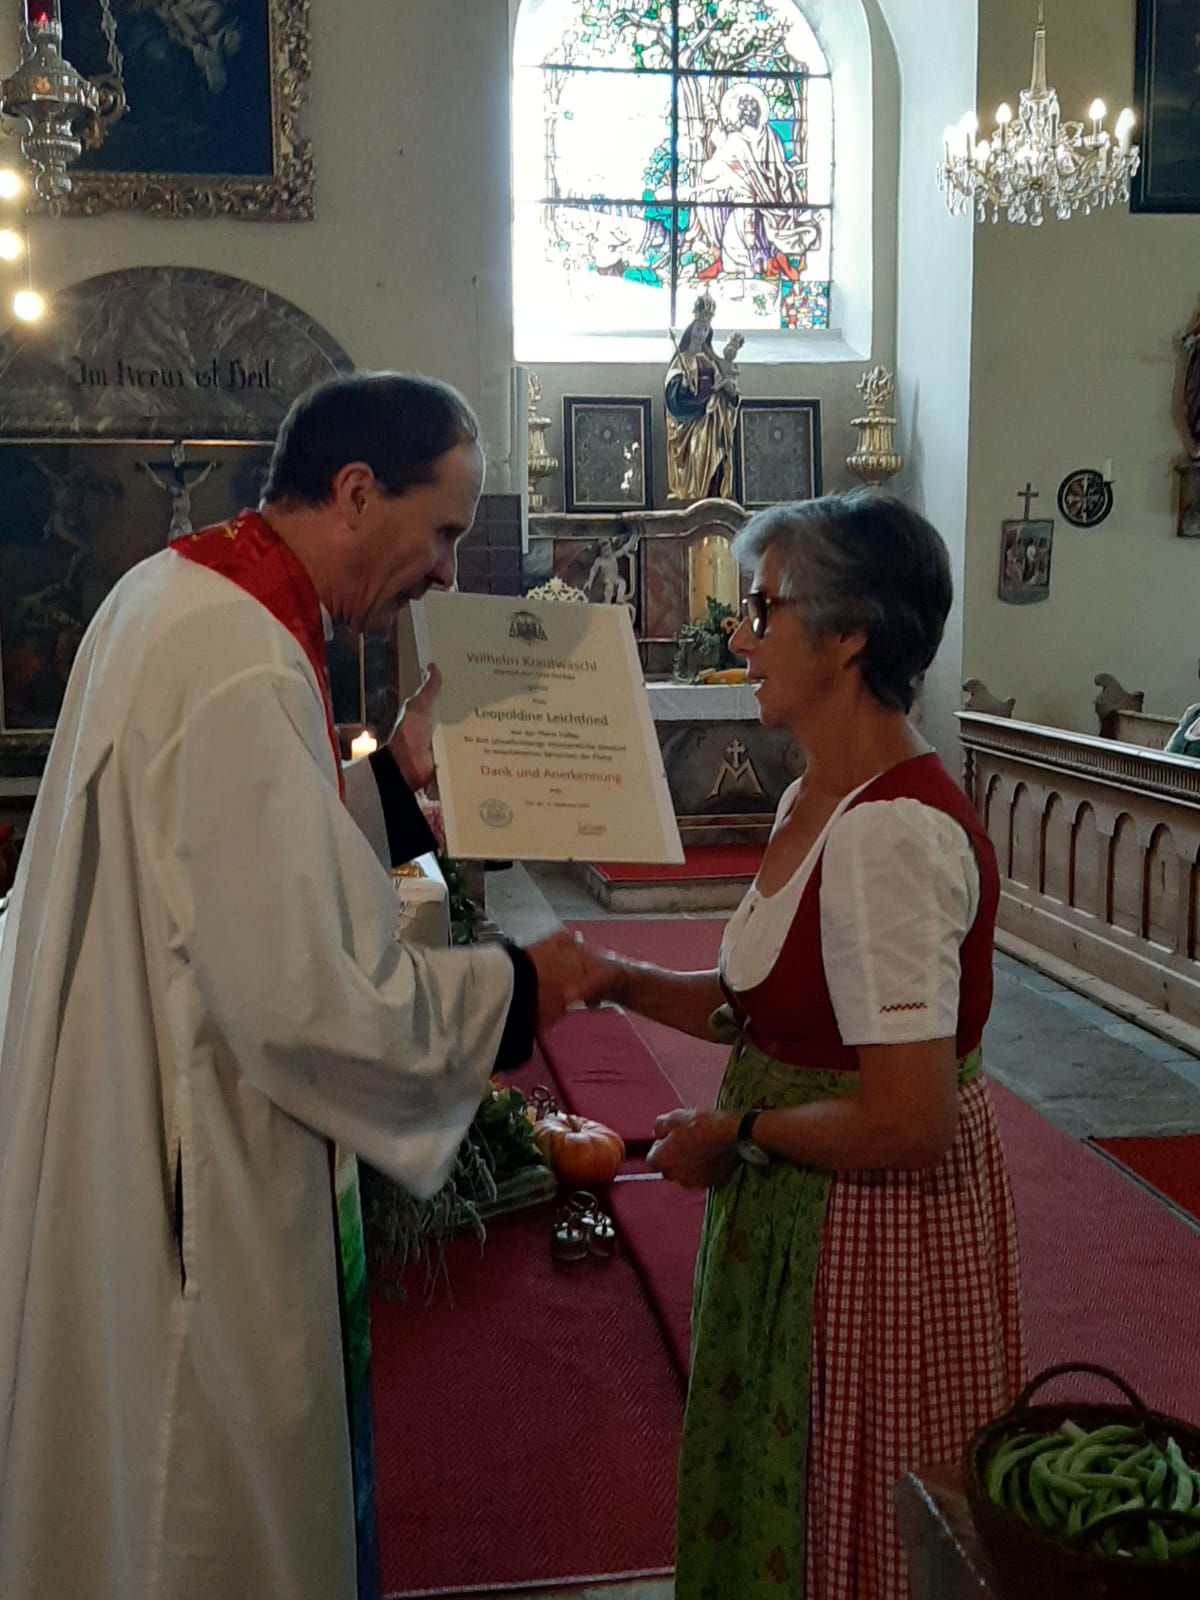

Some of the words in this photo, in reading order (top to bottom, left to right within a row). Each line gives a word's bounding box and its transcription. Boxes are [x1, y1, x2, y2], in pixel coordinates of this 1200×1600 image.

[466, 651, 519, 666] Wilhelm
[474, 706, 543, 722] Leopoldine
[546, 712, 609, 726] Leichtfried
[480, 764, 513, 778] Dank
[517, 767, 540, 779] und
[544, 768, 623, 785] Anerkennung
